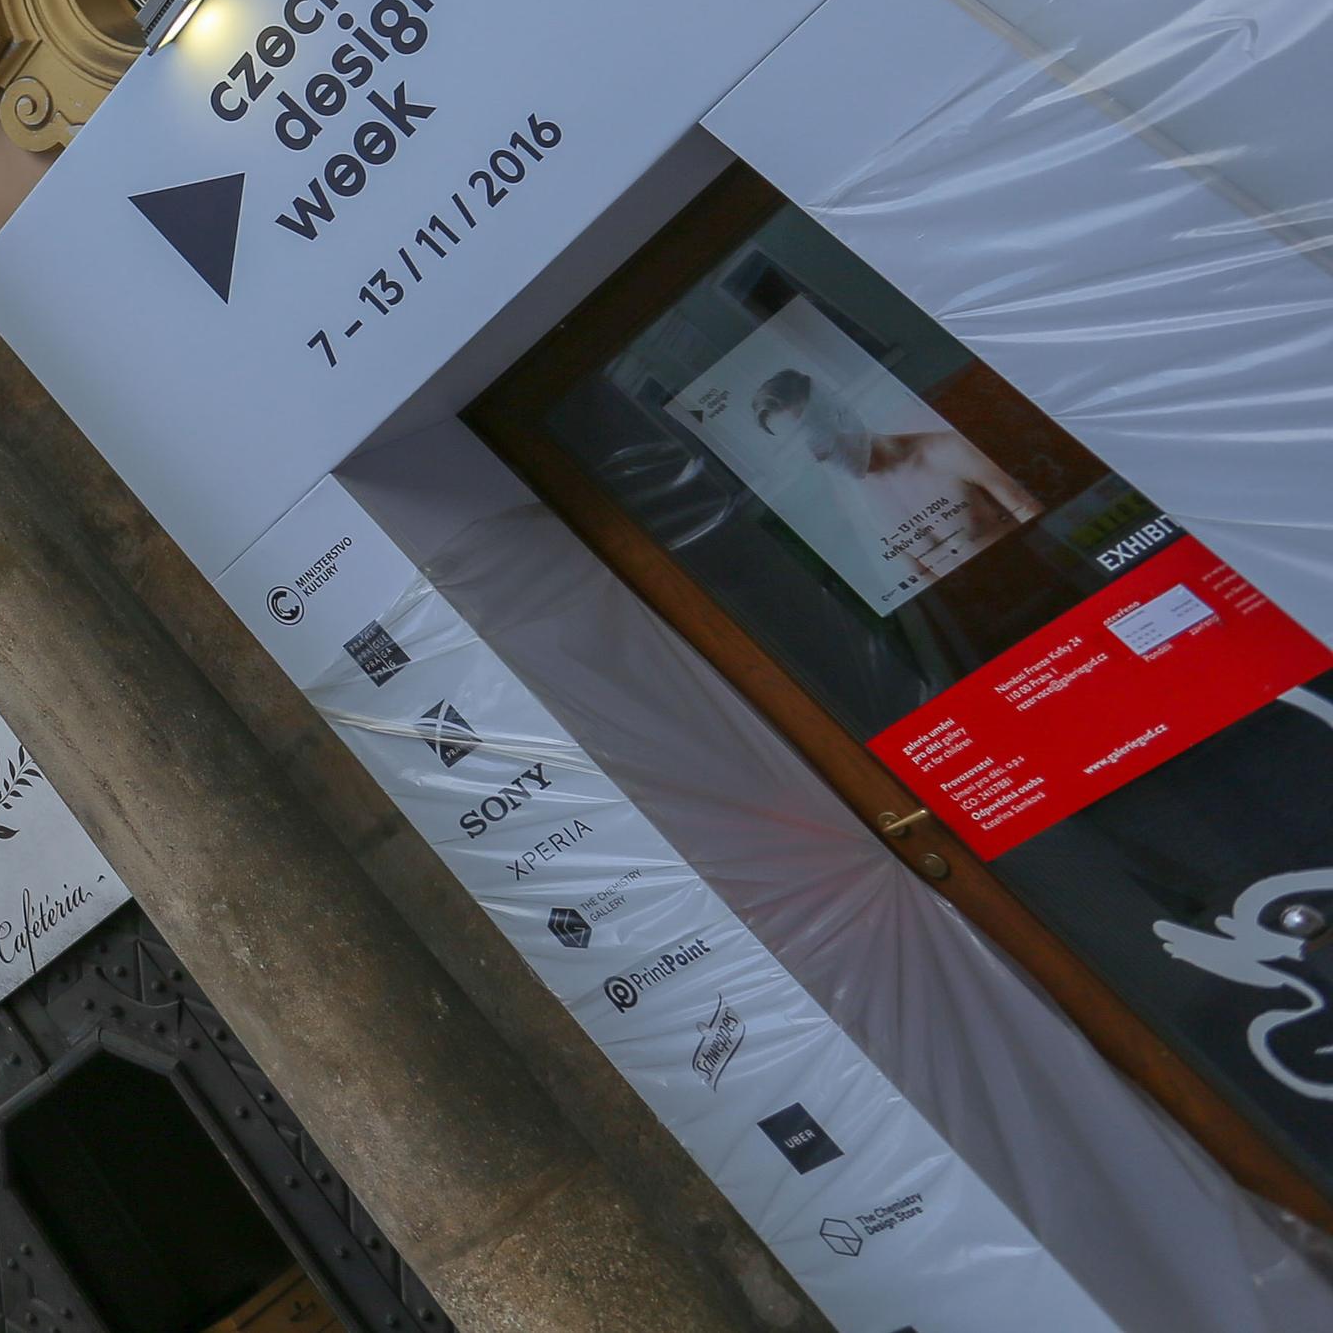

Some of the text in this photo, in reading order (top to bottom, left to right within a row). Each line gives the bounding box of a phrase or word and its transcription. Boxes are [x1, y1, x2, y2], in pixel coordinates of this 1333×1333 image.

[275, 80, 437, 241] week
[307, 329, 337, 368] 7
[469, 113, 562, 208] 2016
[930, 497, 949, 515] 2016
[295, 536, 352, 588] MINISTERSTVO
[302, 563, 339, 597] KULTURY
[1024, 657, 1051, 676] Franze
[1048, 642, 1073, 661] Kafky
[1029, 672, 1053, 688] Praha
[902, 718, 955, 756] galerie umění
[911, 751, 927, 765] pro
[941, 726, 967, 746] gallery
[932, 753, 945, 765] for
[943, 737, 973, 758] children
[1084, 723, 1168, 774] www.galeriegud.cz
[940, 756, 995, 792] Provozovatel
[974, 776, 990, 790] pro
[459, 762, 552, 839] SONY
[971, 776, 1045, 821] Odpovědná osoba
[505, 819, 593, 881] XPERIA
[580, 869, 643, 912] THE CHEMISTRY
[590, 895, 627, 922] GALLERY
[629, 938, 711, 991] PrintPoint
[696, 1011, 739, 1081] Schweppes
[784, 1129, 816, 1149] UBER
[856, 1193, 924, 1226] The Chemistry
[864, 1205, 924, 1236] Design Store
